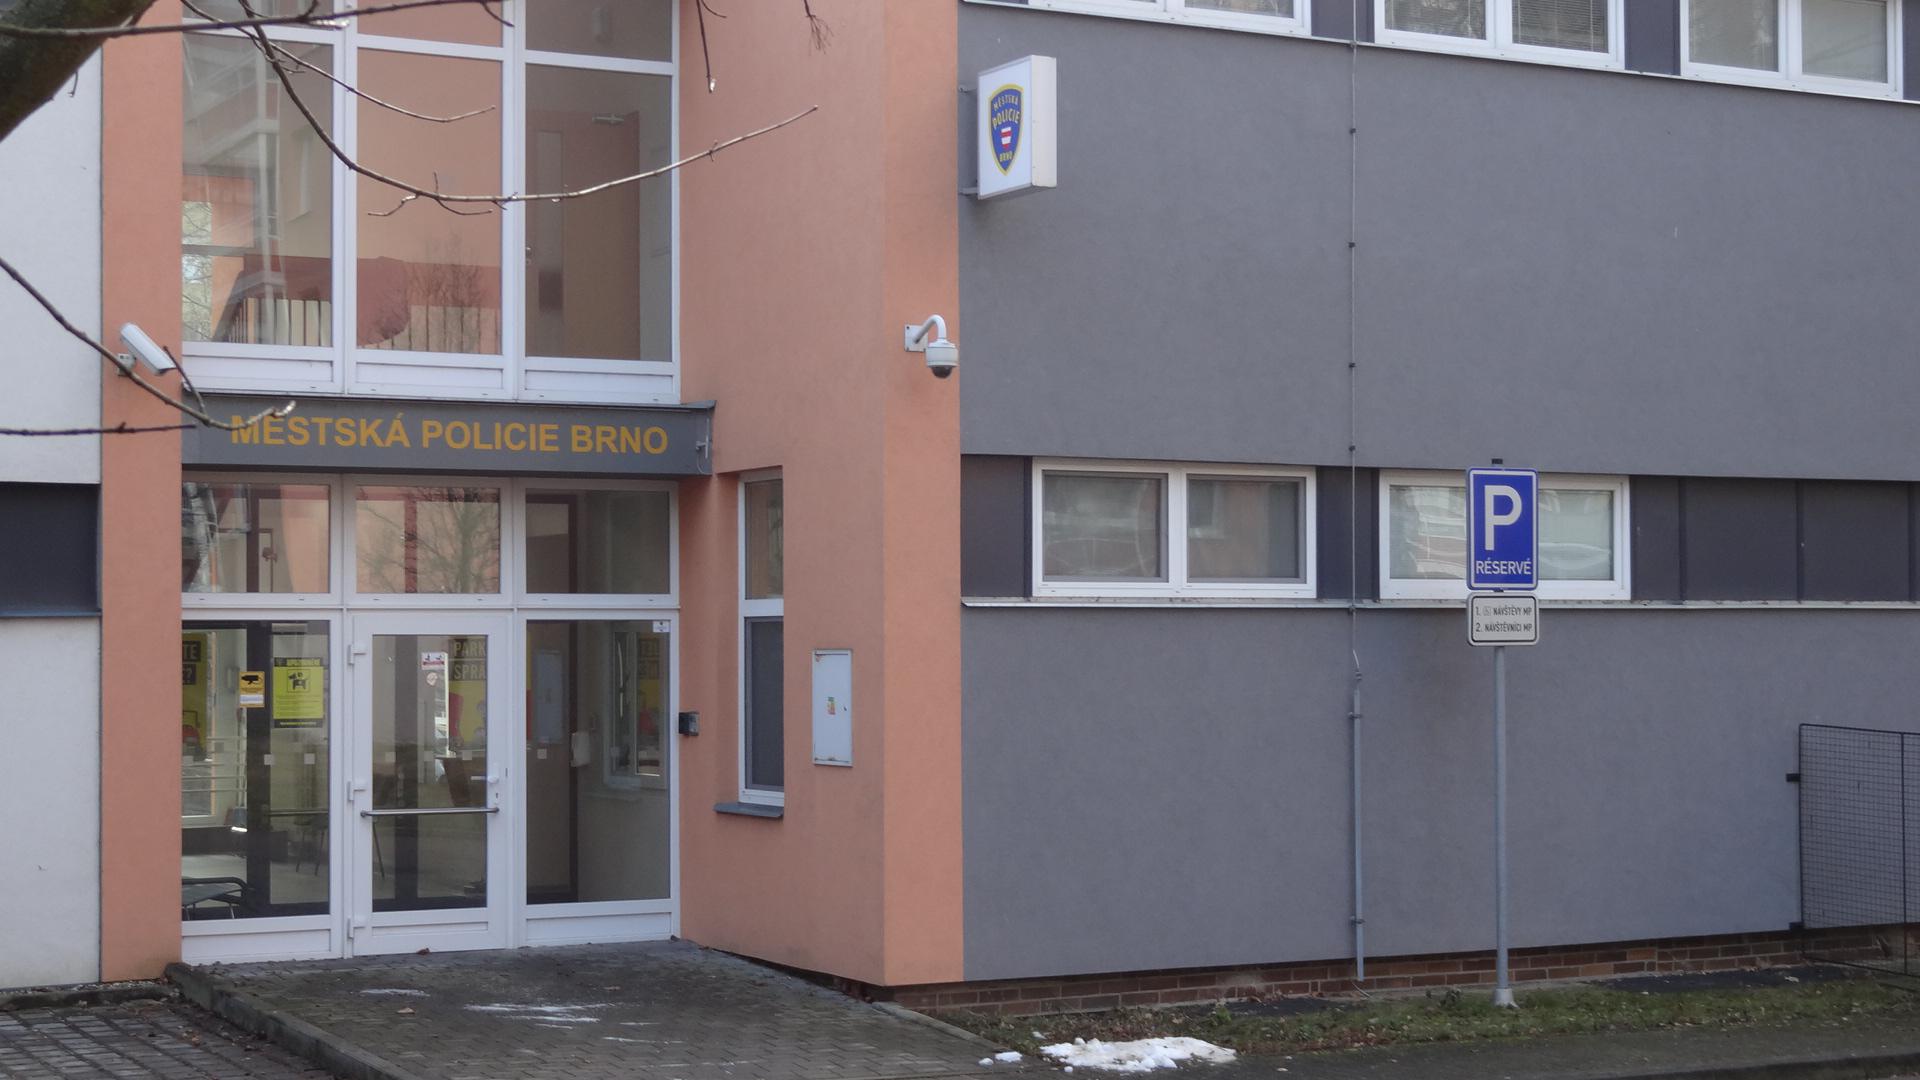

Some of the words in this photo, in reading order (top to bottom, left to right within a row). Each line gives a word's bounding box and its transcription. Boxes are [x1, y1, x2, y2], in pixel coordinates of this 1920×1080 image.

[992, 109, 1020, 130] POLICIE
[1000, 152, 1013, 162] BRNO
[421, 420, 560, 452] POLICIE
[570, 424, 668, 455] BRNO
[1484, 485, 1523, 551] P
[1475, 557, 1532, 575] RÉSERVÉ
[1523, 606, 1532, 616] MP
